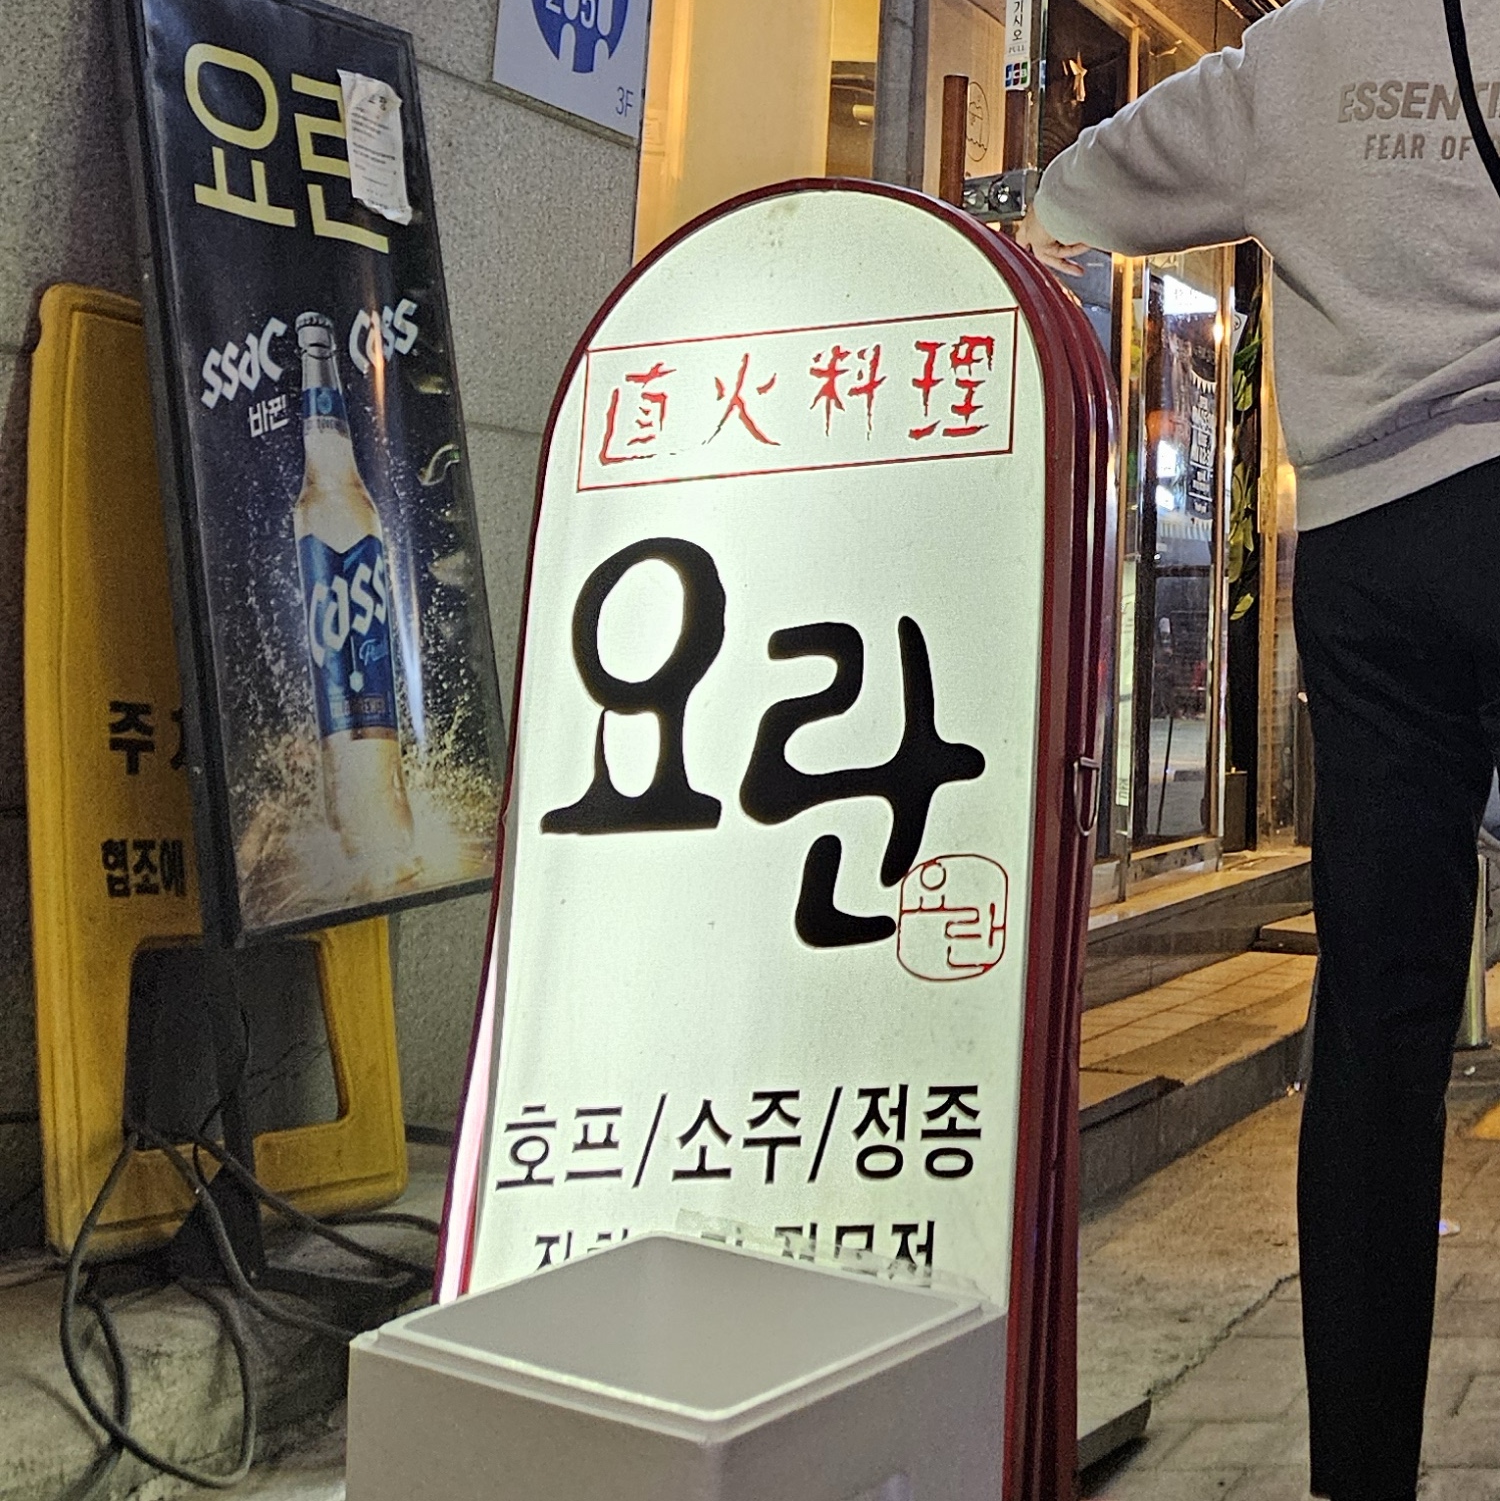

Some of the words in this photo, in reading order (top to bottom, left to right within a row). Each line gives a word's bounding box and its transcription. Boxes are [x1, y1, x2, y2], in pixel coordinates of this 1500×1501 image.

[1005, 61, 1029, 88] JCB
[615, 86, 634, 117] 3F
[1364, 133, 1426, 160] FEAR
[1441, 135, 1474, 161] OF
[600, 334, 995, 467] 直火料理
[540, 536, 987, 948] 요란
